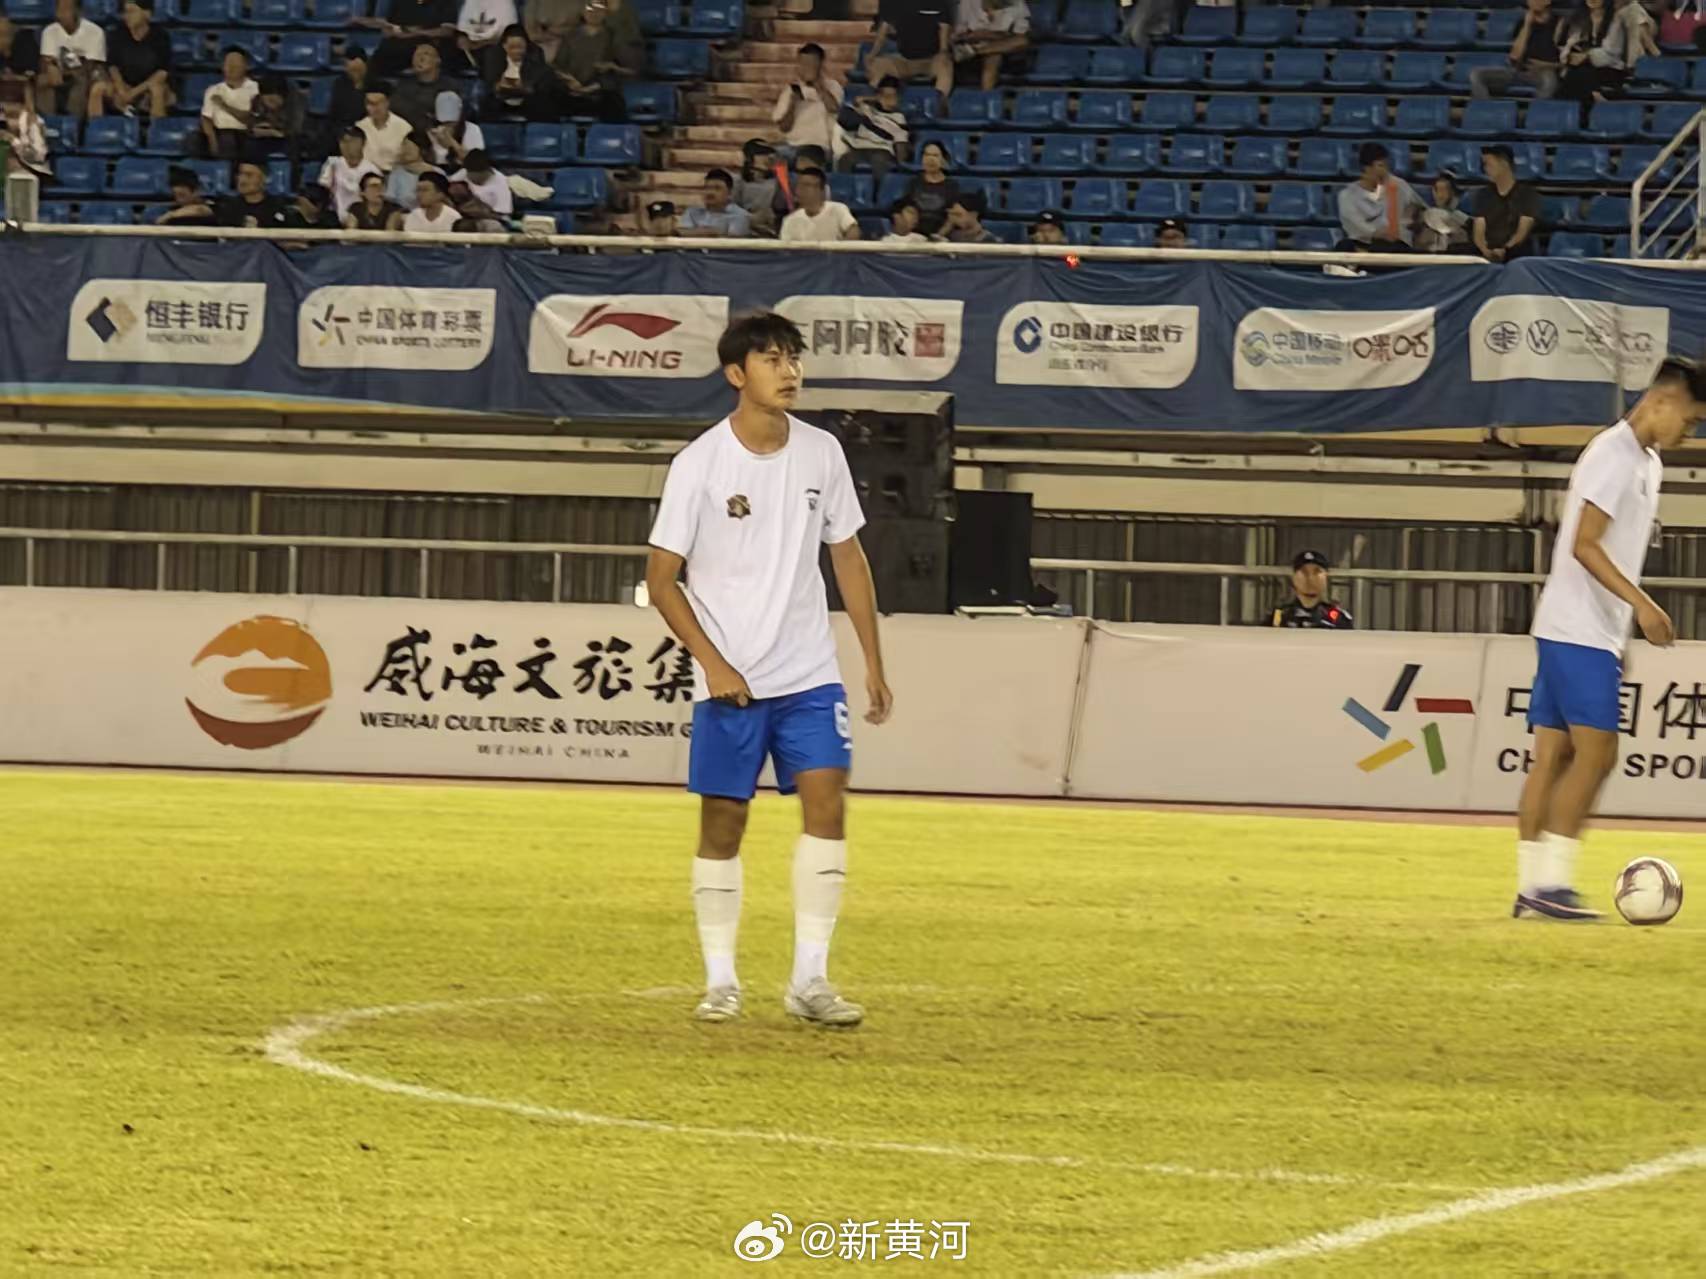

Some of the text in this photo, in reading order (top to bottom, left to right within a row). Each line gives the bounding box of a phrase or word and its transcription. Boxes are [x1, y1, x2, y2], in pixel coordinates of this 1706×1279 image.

[145, 300, 249, 330] 恒丰银行
[357, 307, 482, 332] 中国体育彩票
[1050, 322, 1185, 344] 中国建设银行
[567, 348, 683, 370] LI-NING
[361, 711, 439, 730] WEIHAI
[445, 714, 545, 733] CULTURE
[550, 718, 567, 734] &
[573, 718, 675, 737] TOURISM
[564, 746, 630, 759] CHINA
[1624, 753, 1706, 779] SPO
